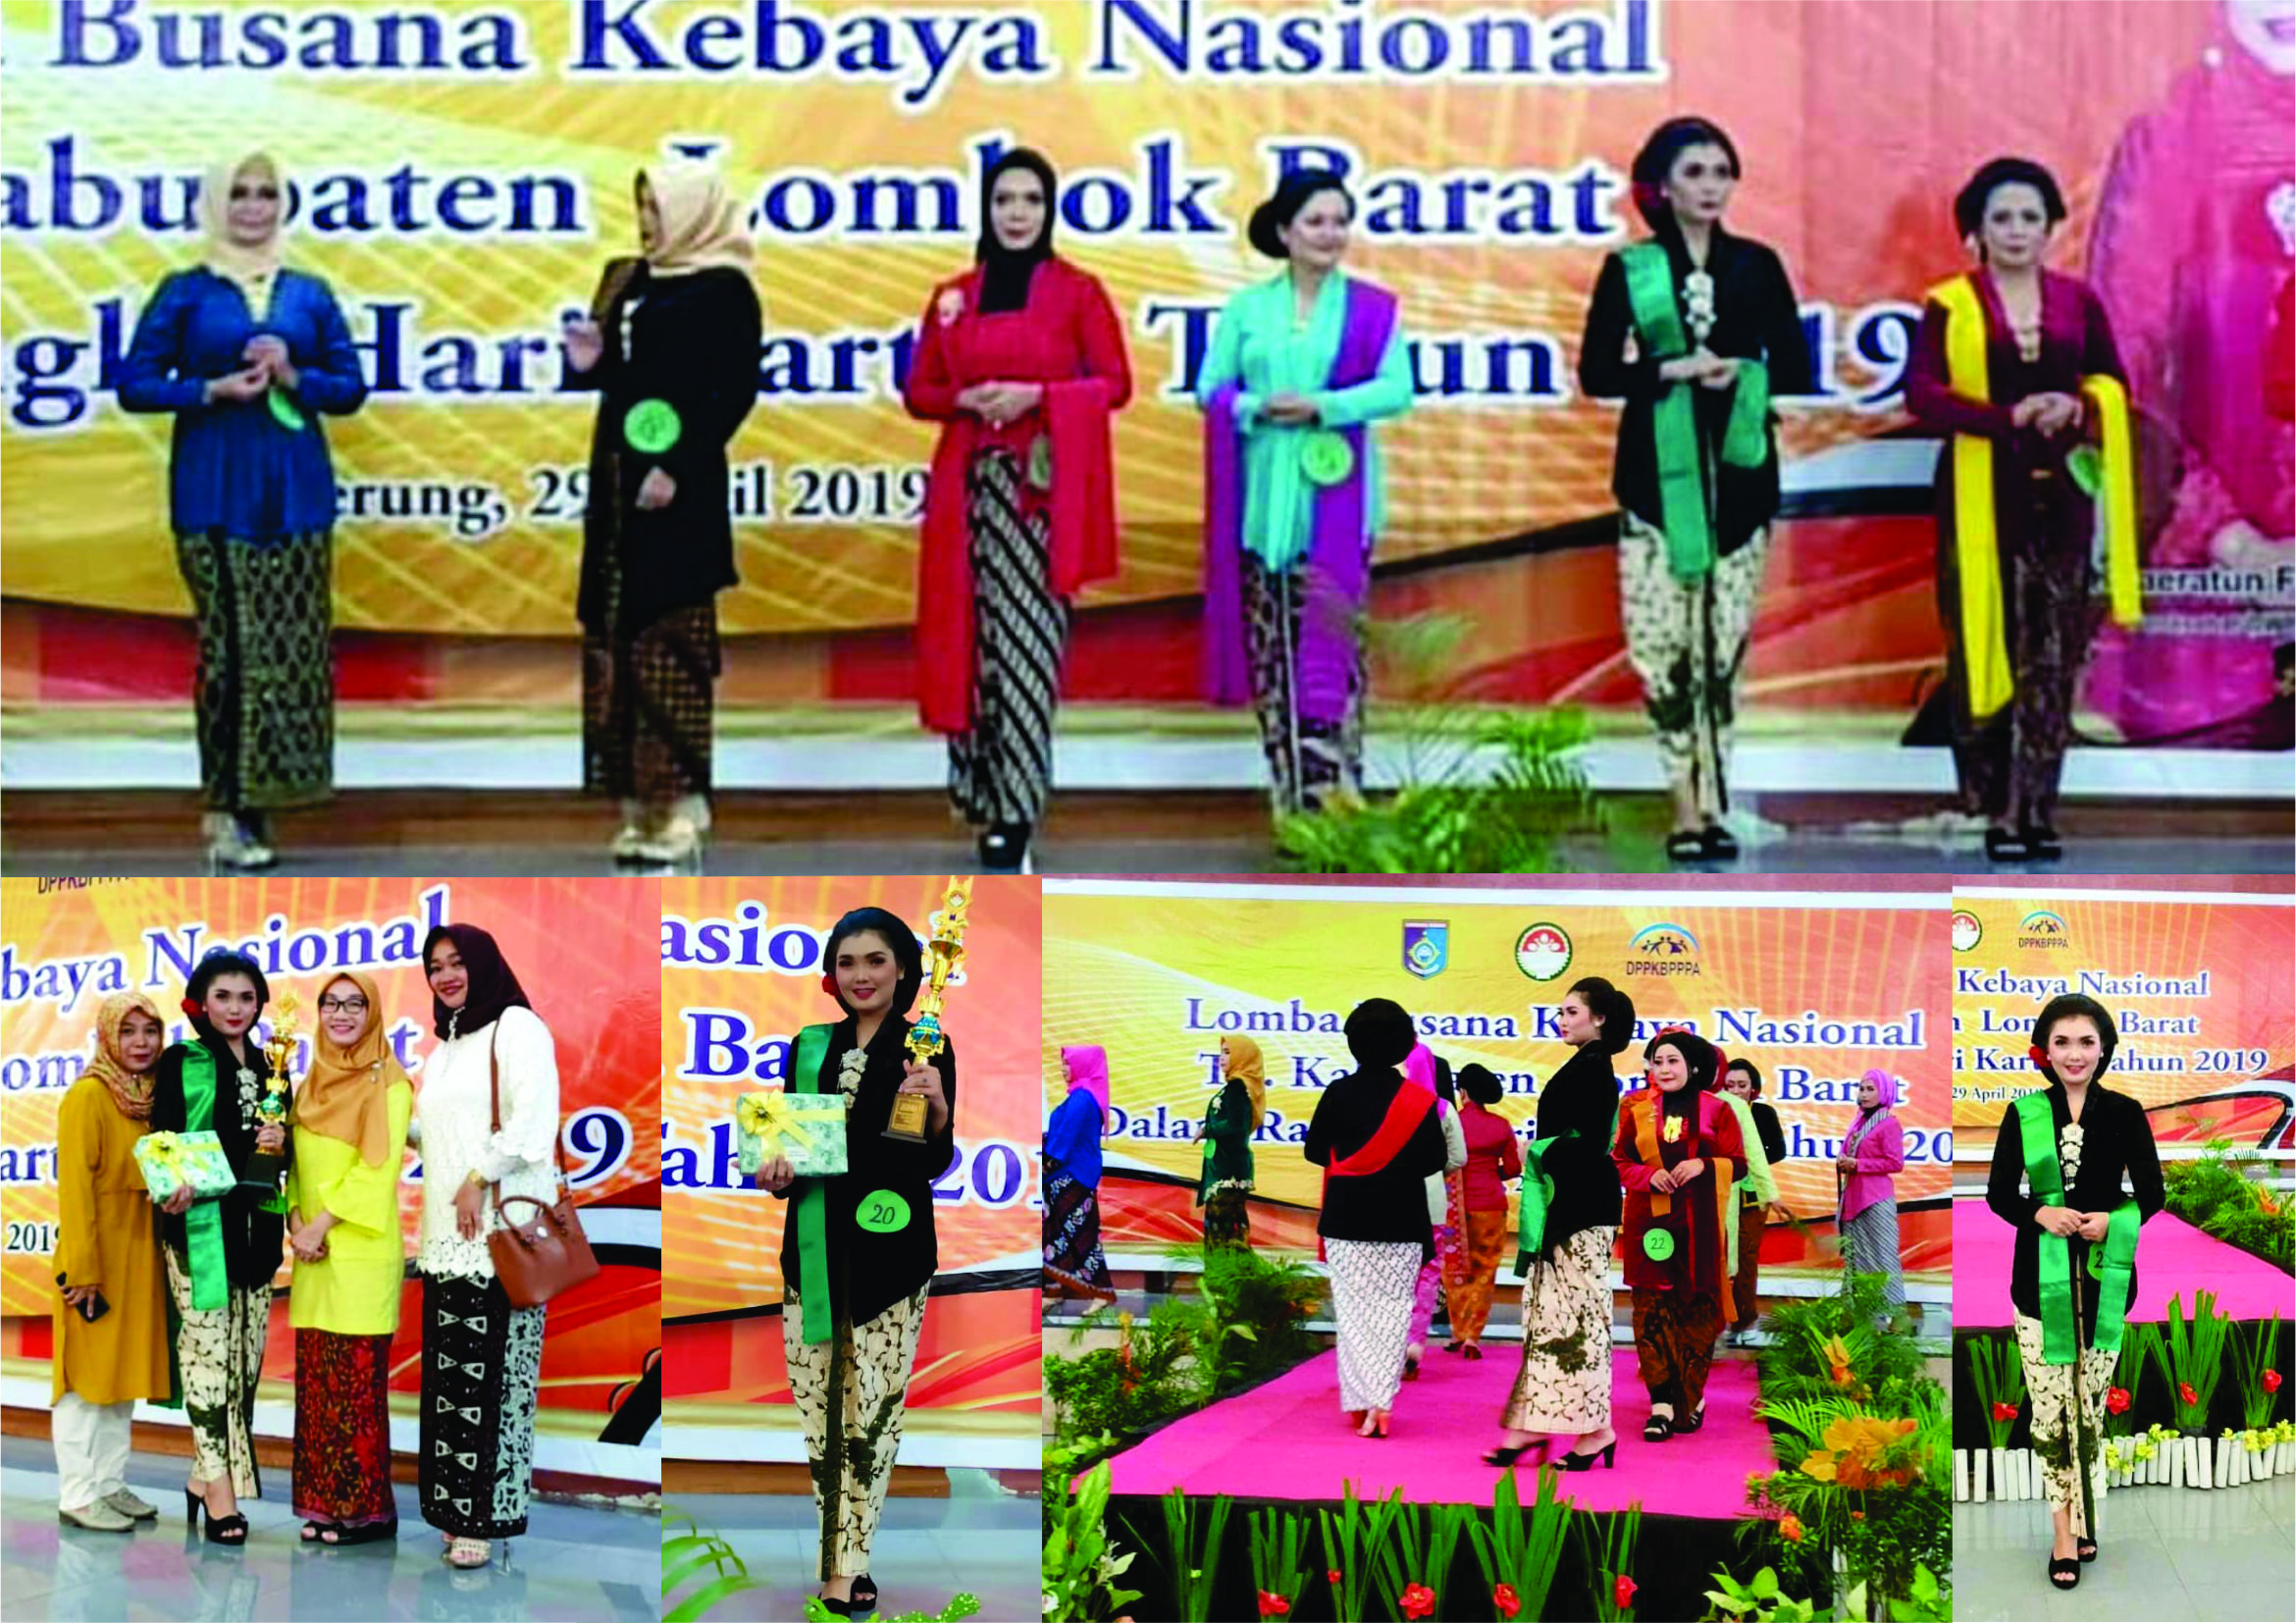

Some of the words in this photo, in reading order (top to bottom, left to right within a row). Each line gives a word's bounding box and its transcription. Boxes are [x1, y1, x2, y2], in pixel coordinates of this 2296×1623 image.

[50, 0, 527, 70] Busana
[570, 0, 1050, 103] Kebaya
[1091, 0, 1656, 75] Nasional
[0, 133, 586, 232] abuaten
[670, 138, 1226, 235] omok
[792, 469, 930, 519] 2019
[1, 948, 128, 1012] baya
[1626, 961, 1700, 976] DPPKBPPPA
[1957, 969, 2068, 1001] Kebaya
[2078, 970, 2209, 996] Nasional
[1185, 998, 1341, 1033] Lomba
[1714, 1010, 1924, 1047] Nasional
[2119, 1011, 2199, 1034] Barat
[2111, 1048, 2184, 1073] ahun
[2195, 1050, 2269, 1073] 2019
[1972, 1086, 2006, 1103] April
[868, 1203, 896, 1225] 20
[1650, 1237, 1666, 1250] 22
